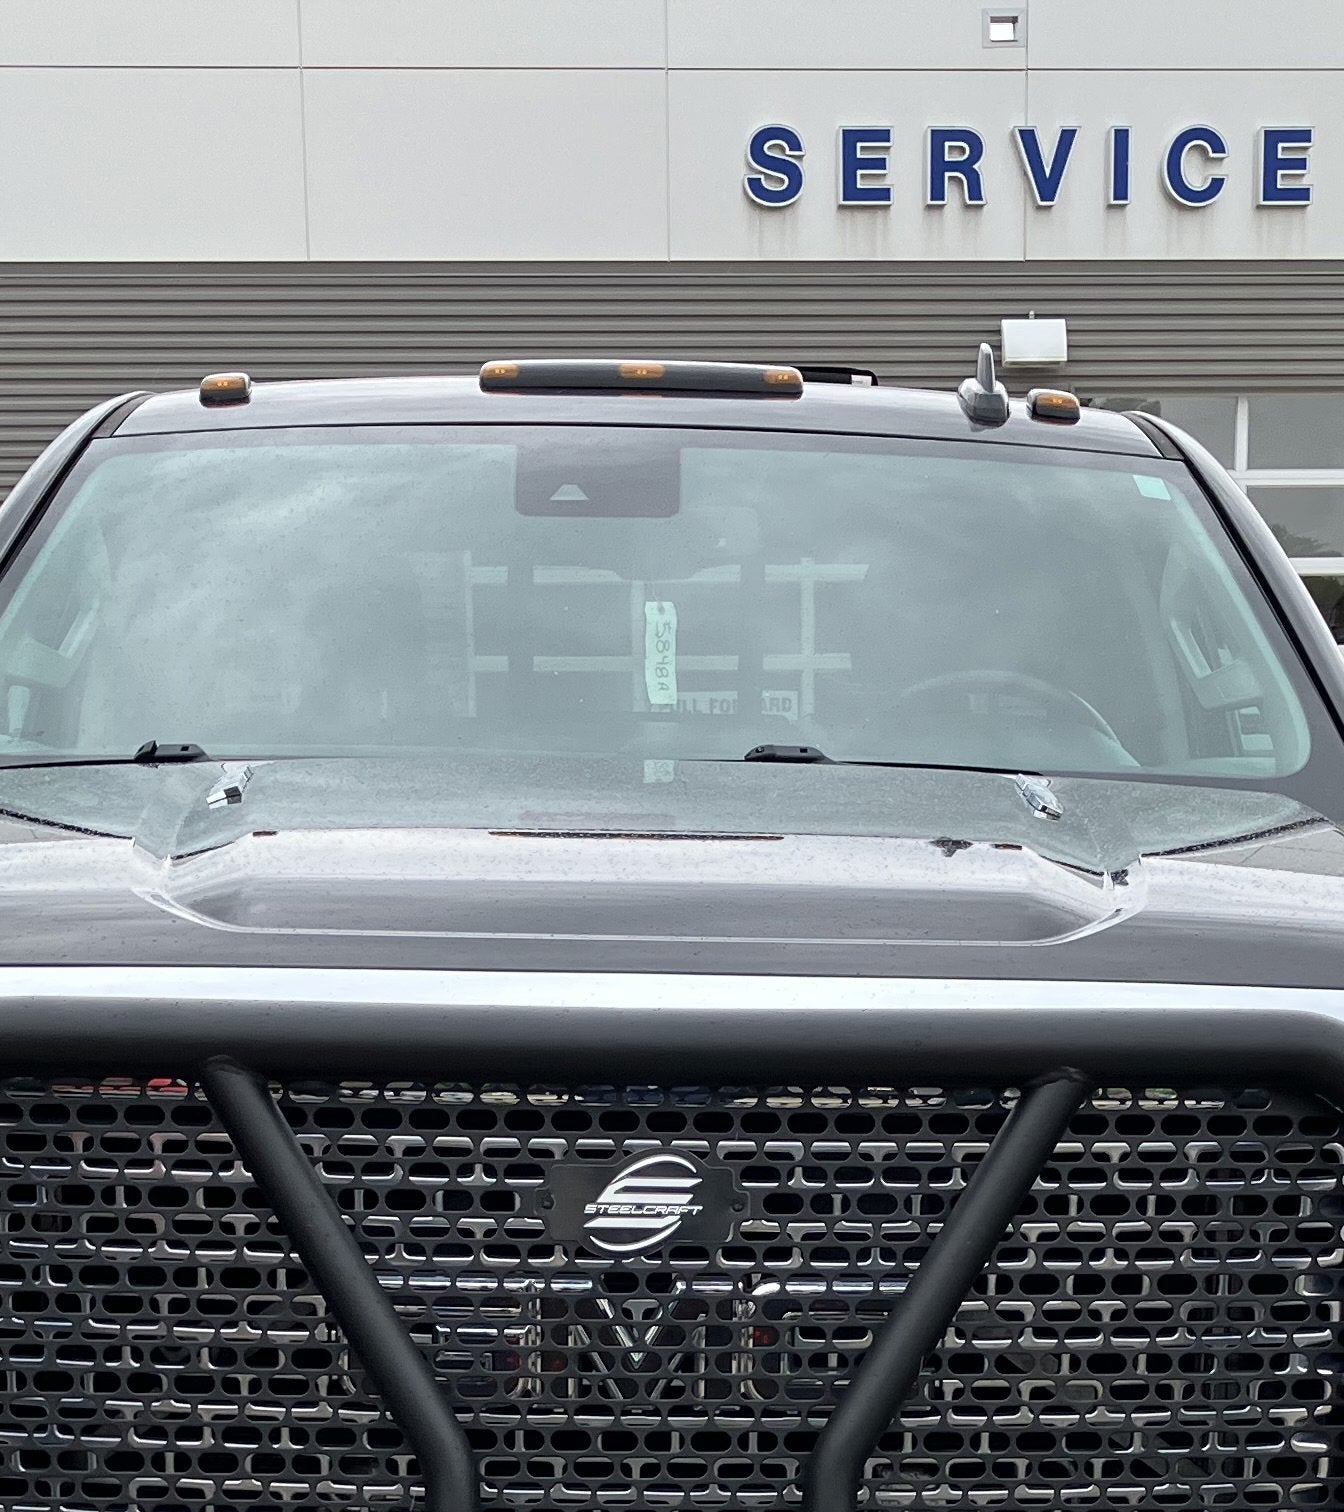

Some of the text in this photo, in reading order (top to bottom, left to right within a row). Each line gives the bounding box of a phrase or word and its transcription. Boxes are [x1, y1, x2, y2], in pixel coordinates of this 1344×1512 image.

[743, 124, 1315, 206] SERVICE
[655, 621, 672, 691] 5848A
[583, 1203, 703, 1216] STEELCRAFT
